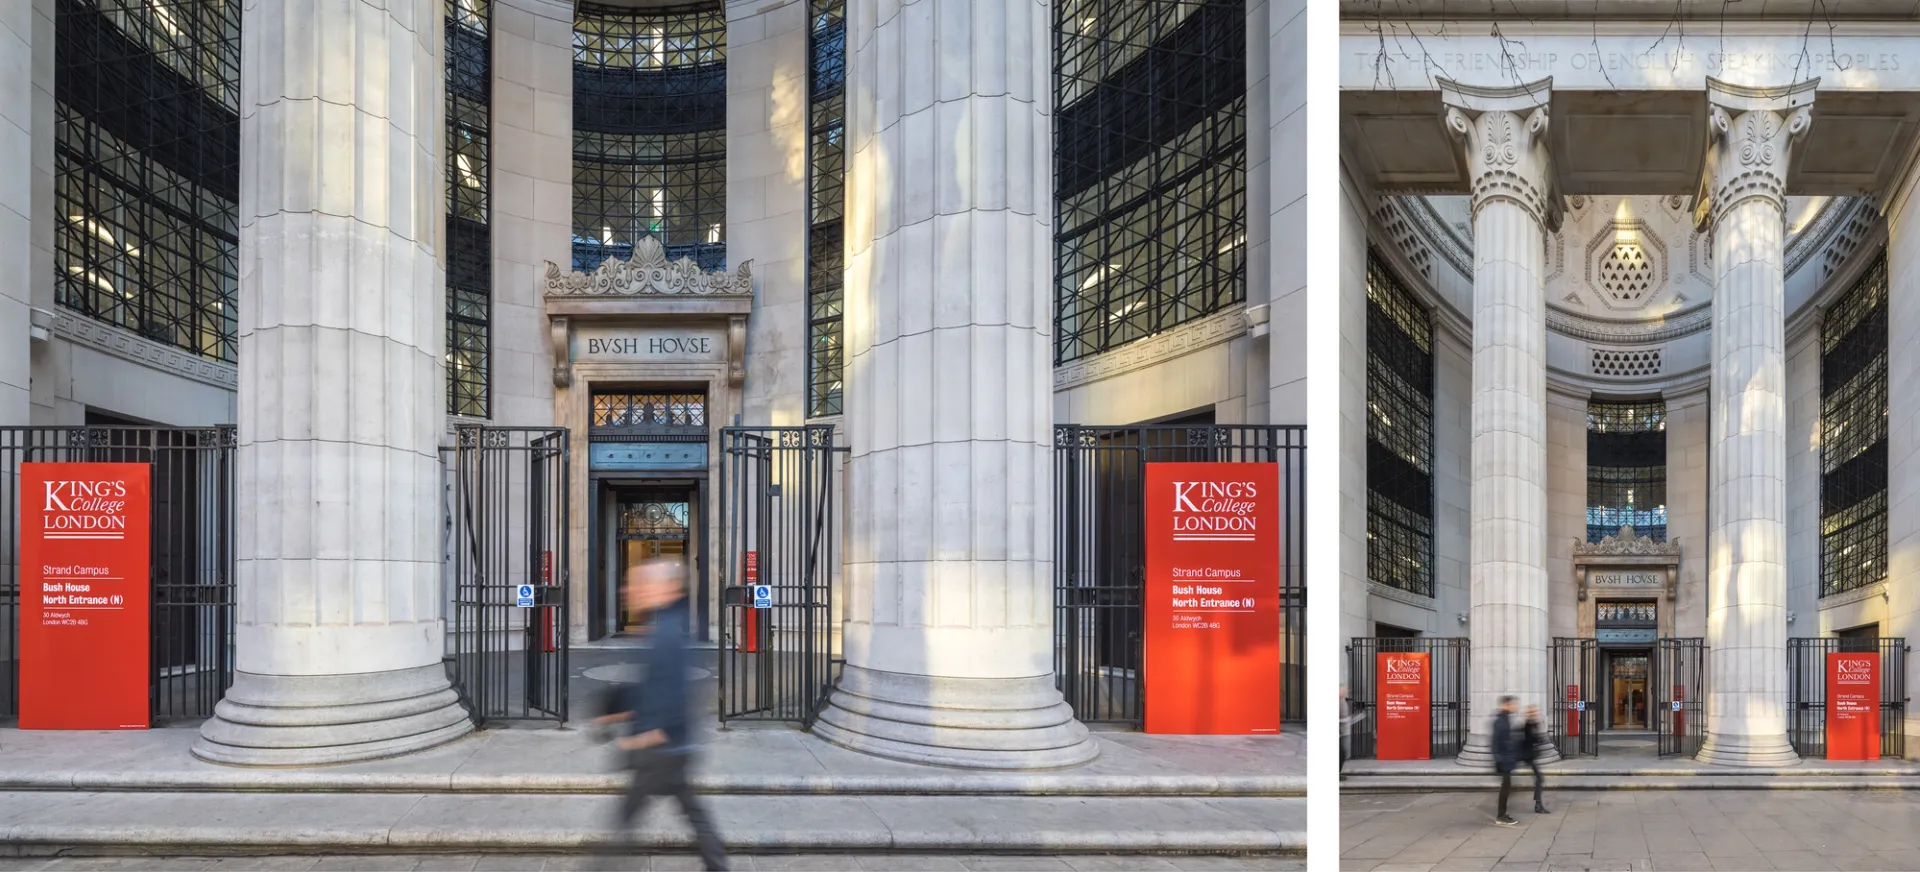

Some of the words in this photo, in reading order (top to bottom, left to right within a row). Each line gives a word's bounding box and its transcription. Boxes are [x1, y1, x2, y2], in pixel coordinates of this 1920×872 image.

[1391, 52, 1430, 71] THE
[1444, 52, 1557, 70] FRIENDSHIP
[1571, 52, 1597, 70] OF
[1608, 52, 1693, 71] ENGLISH
[1706, 52, 1802, 71] SPEAKING
[1815, 52, 1899, 71] PEOPLES
[43, 480, 126, 511] KING'S
[1172, 481, 1257, 512] KING'S
[70, 497, 125, 514] College
[1201, 498, 1256, 516] College
[43, 515, 126, 529] LONDON
[1173, 516, 1257, 531] LONDON
[43, 565, 72, 575] Strand
[73, 565, 109, 576] Campus
[1172, 567, 1203, 577] Strand
[1205, 567, 1241, 578] Campus
[43, 583, 63, 592] Bush
[65, 583, 90, 592] House
[1172, 585, 1194, 595] Bush
[1196, 585, 1223, 595] House
[43, 595, 67, 604] North
[69, 595, 108, 604] Entrance
[110, 595, 124, 605] (N)
[1172, 598, 1198, 608] North
[1200, 598, 1240, 608] Entrance
[1242, 597, 1255, 608] (N)
[1387, 660, 1420, 672] KING'S
[1837, 660, 1871, 672] KING'S
